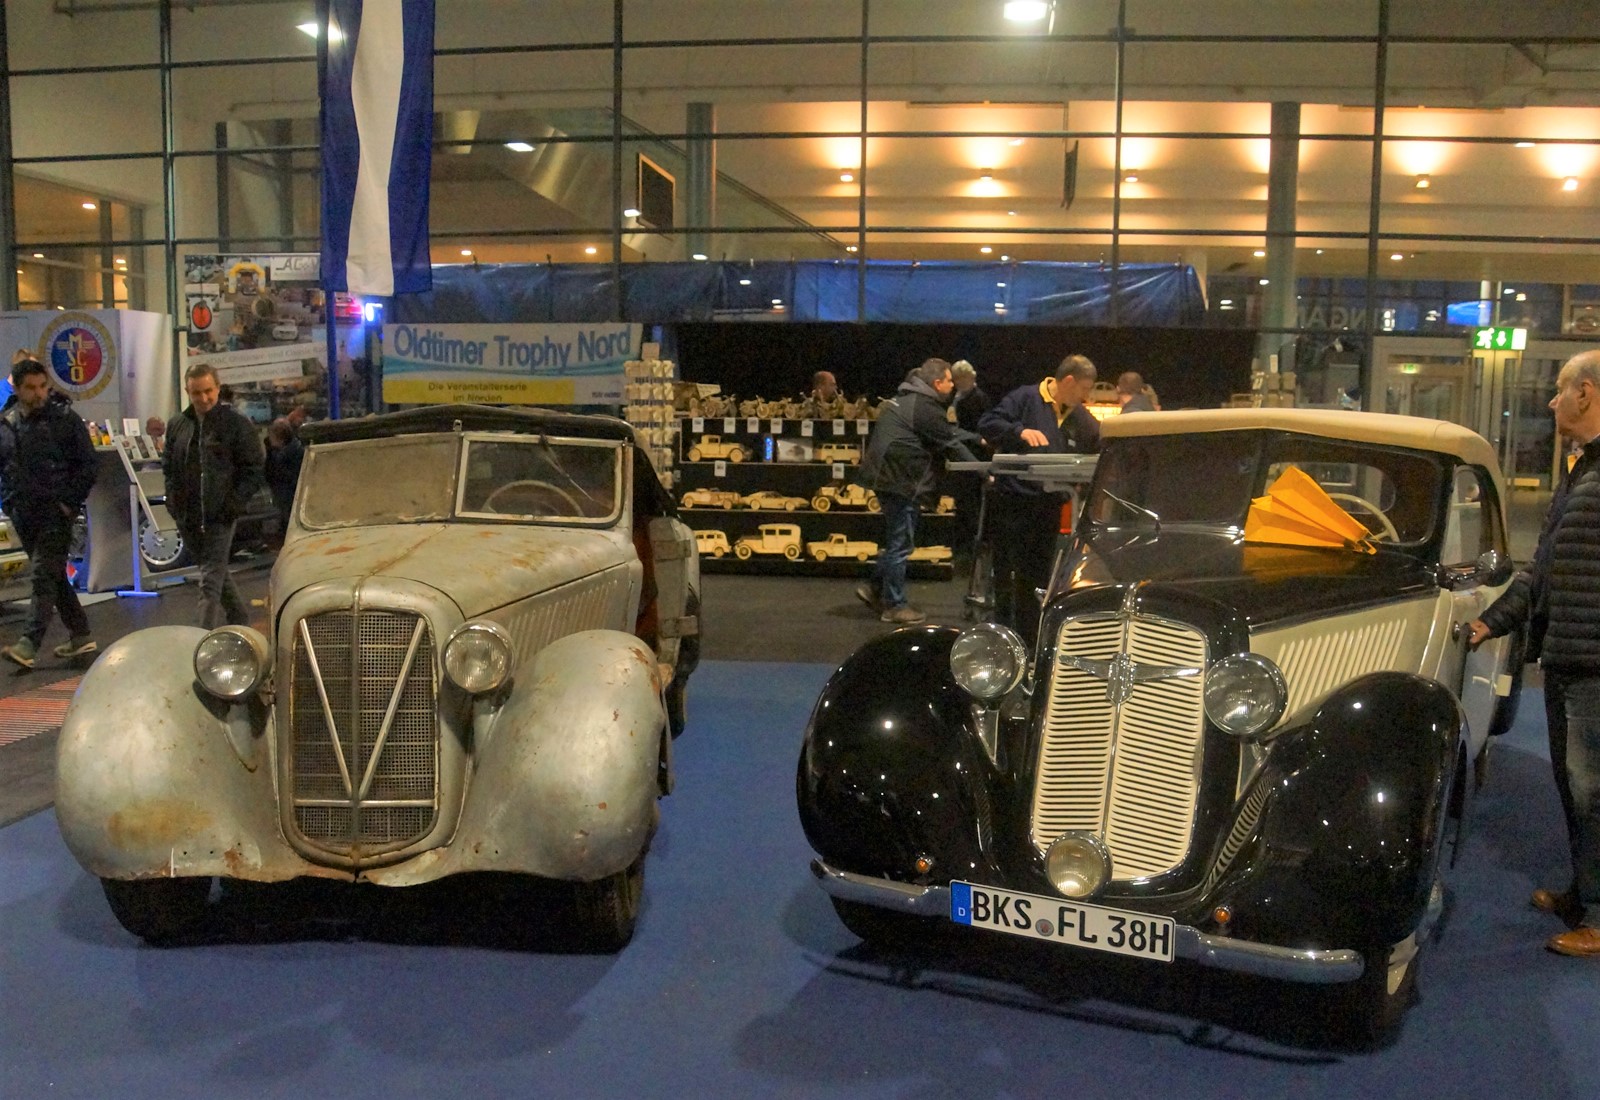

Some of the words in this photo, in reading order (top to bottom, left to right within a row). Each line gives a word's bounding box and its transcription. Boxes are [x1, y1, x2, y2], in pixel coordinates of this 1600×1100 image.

[393, 325, 488, 366] Oldtimer
[494, 334, 571, 375] Trophy
[577, 324, 631, 362] Nord
[428, 382, 444, 391] Die
[447, 382, 527, 391] Veranstalterserie
[467, 393, 503, 402] Norden
[958, 906, 965, 916] D
[972, 890, 1032, 929] BKS
[1058, 906, 1098, 943] FL
[1107, 914, 1170, 955] 38H
